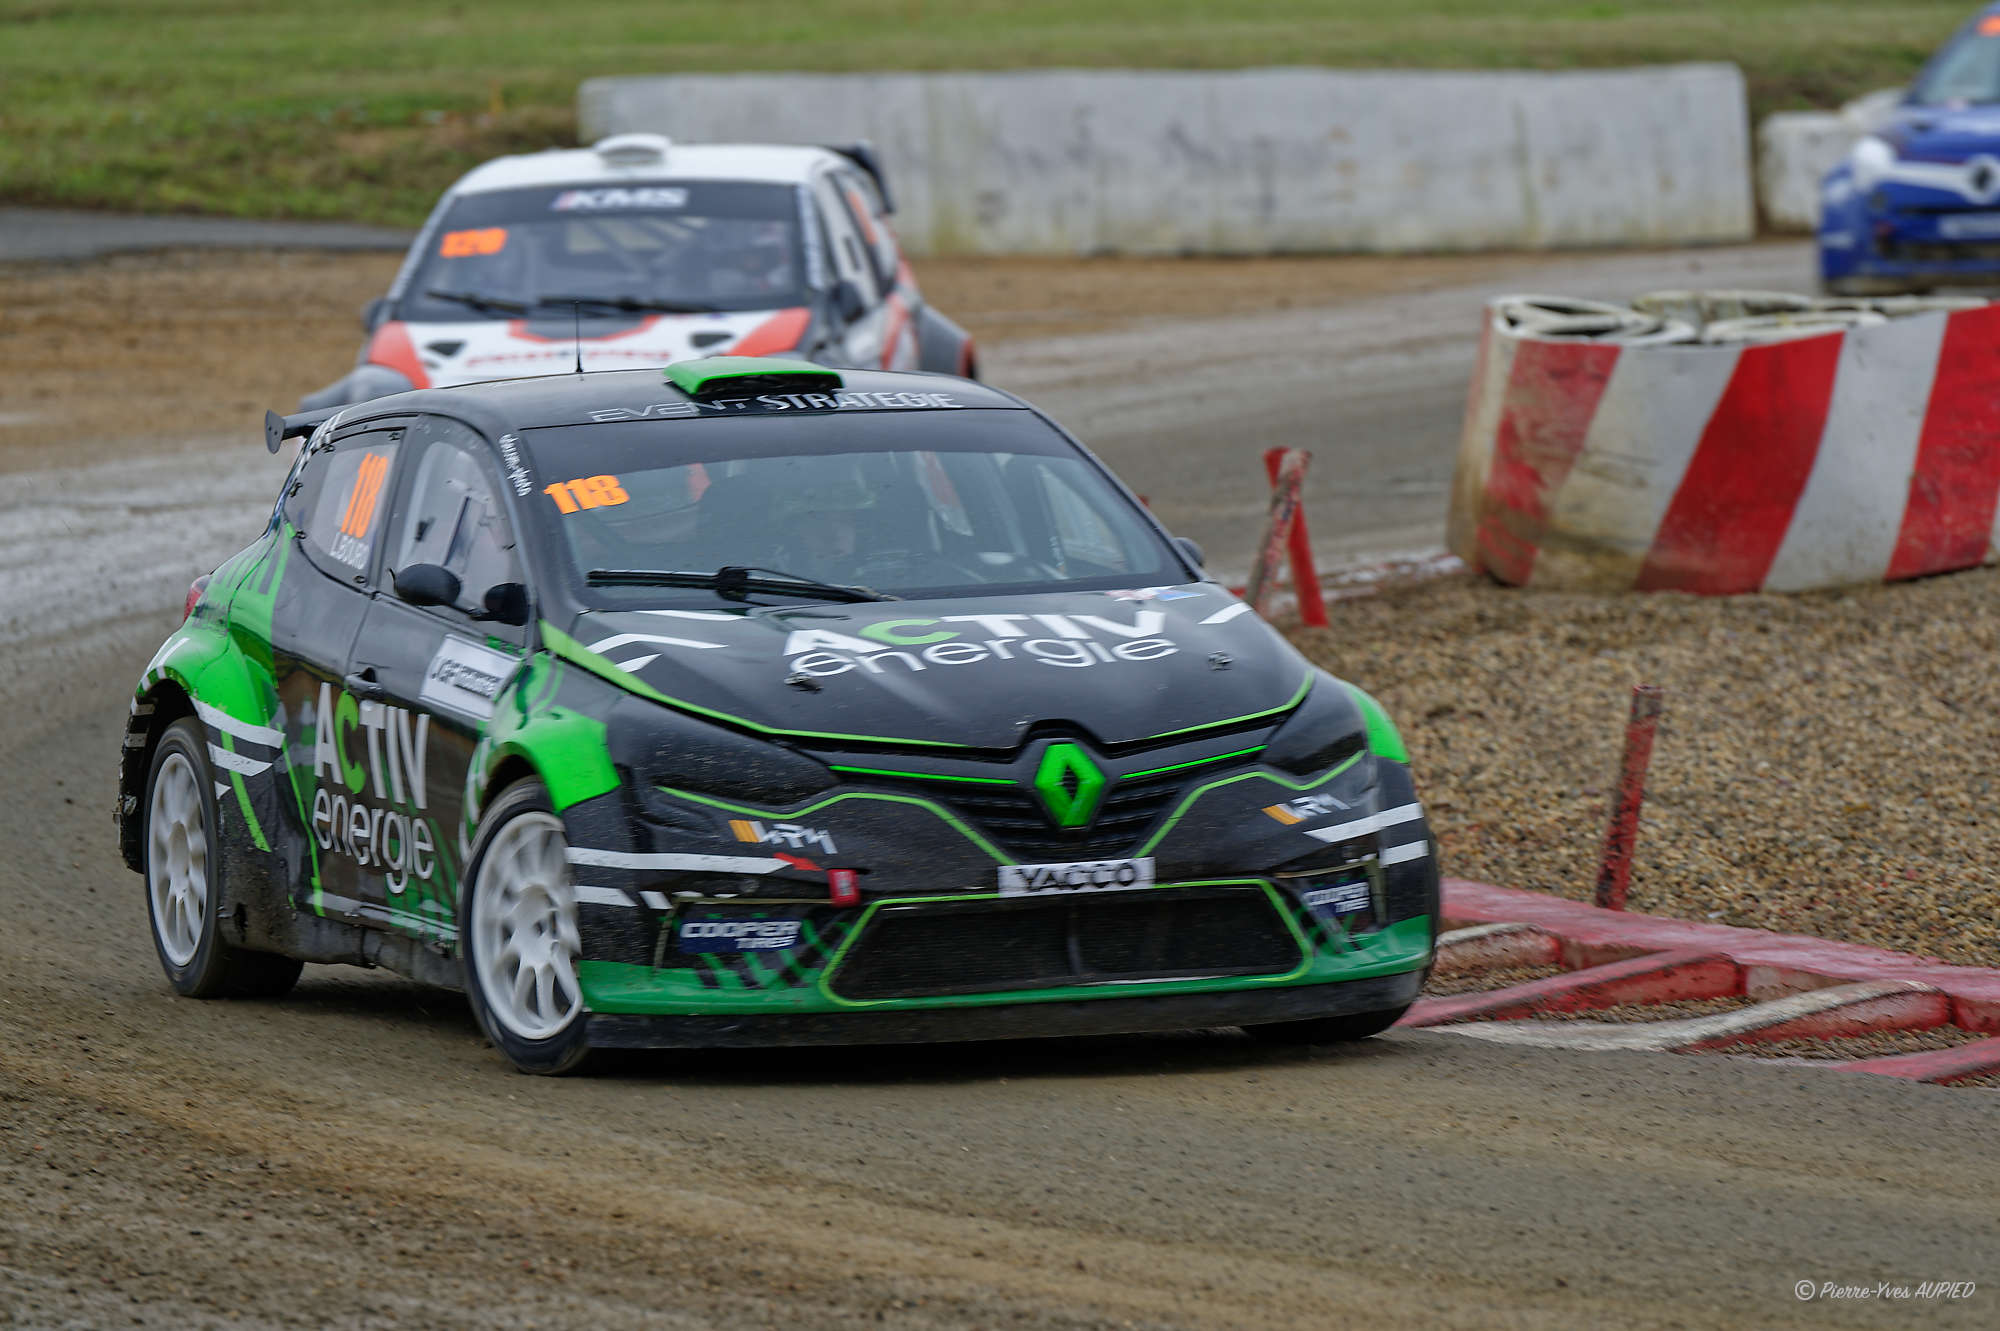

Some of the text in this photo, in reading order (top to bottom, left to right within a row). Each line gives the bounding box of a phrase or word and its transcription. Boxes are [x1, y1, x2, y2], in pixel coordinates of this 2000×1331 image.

[591, 391, 964, 422] EVENT STRATEGIE
[340, 452, 388, 539] 118
[543, 474, 630, 514] 118
[783, 609, 1166, 657] ACTIV
[789, 638, 1180, 677] energie
[314, 681, 430, 810] ACTIV
[313, 788, 434, 894] energie
[1015, 863, 1137, 892] YACCO
[680, 921, 802, 938] COOPER
